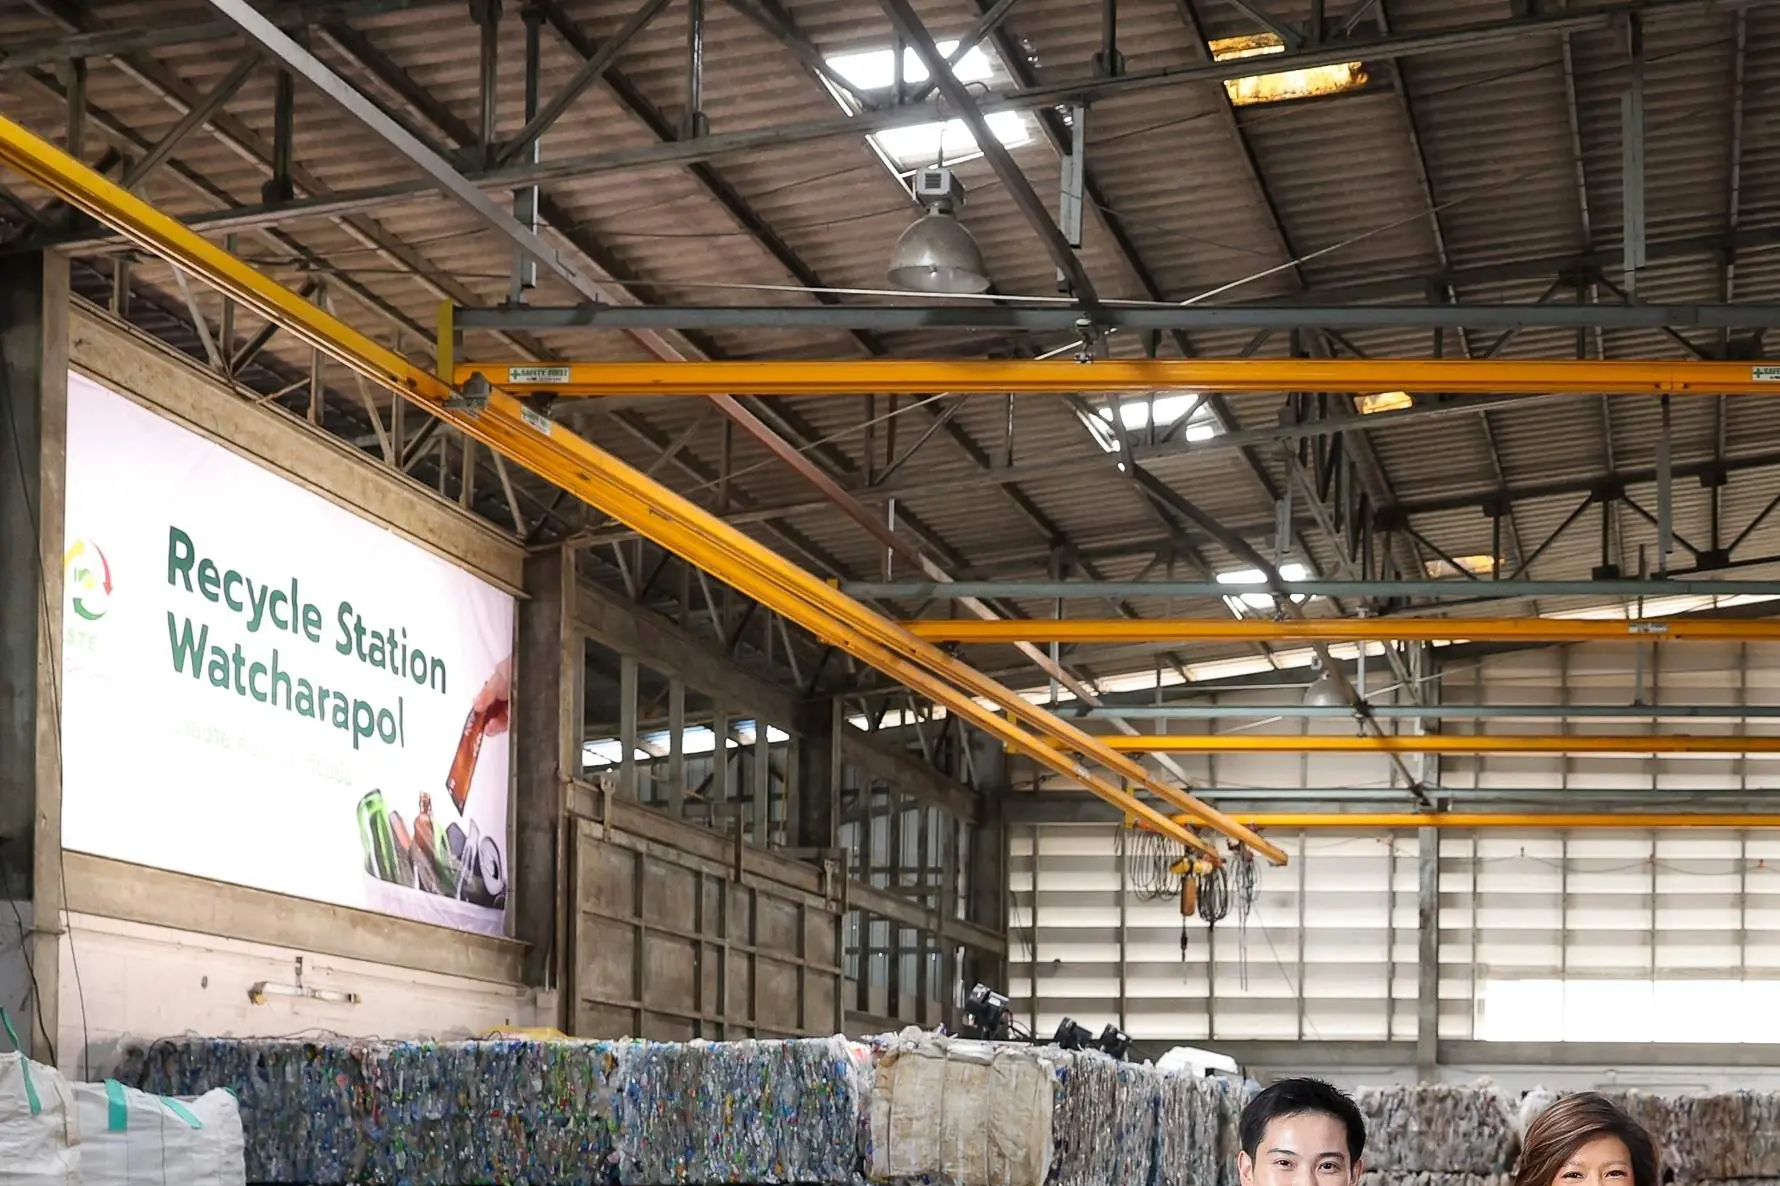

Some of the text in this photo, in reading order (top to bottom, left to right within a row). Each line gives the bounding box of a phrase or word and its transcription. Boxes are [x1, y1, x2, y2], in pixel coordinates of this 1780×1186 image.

[166, 610, 406, 751] Watcharapol
[167, 525, 448, 695] Recycle Station
